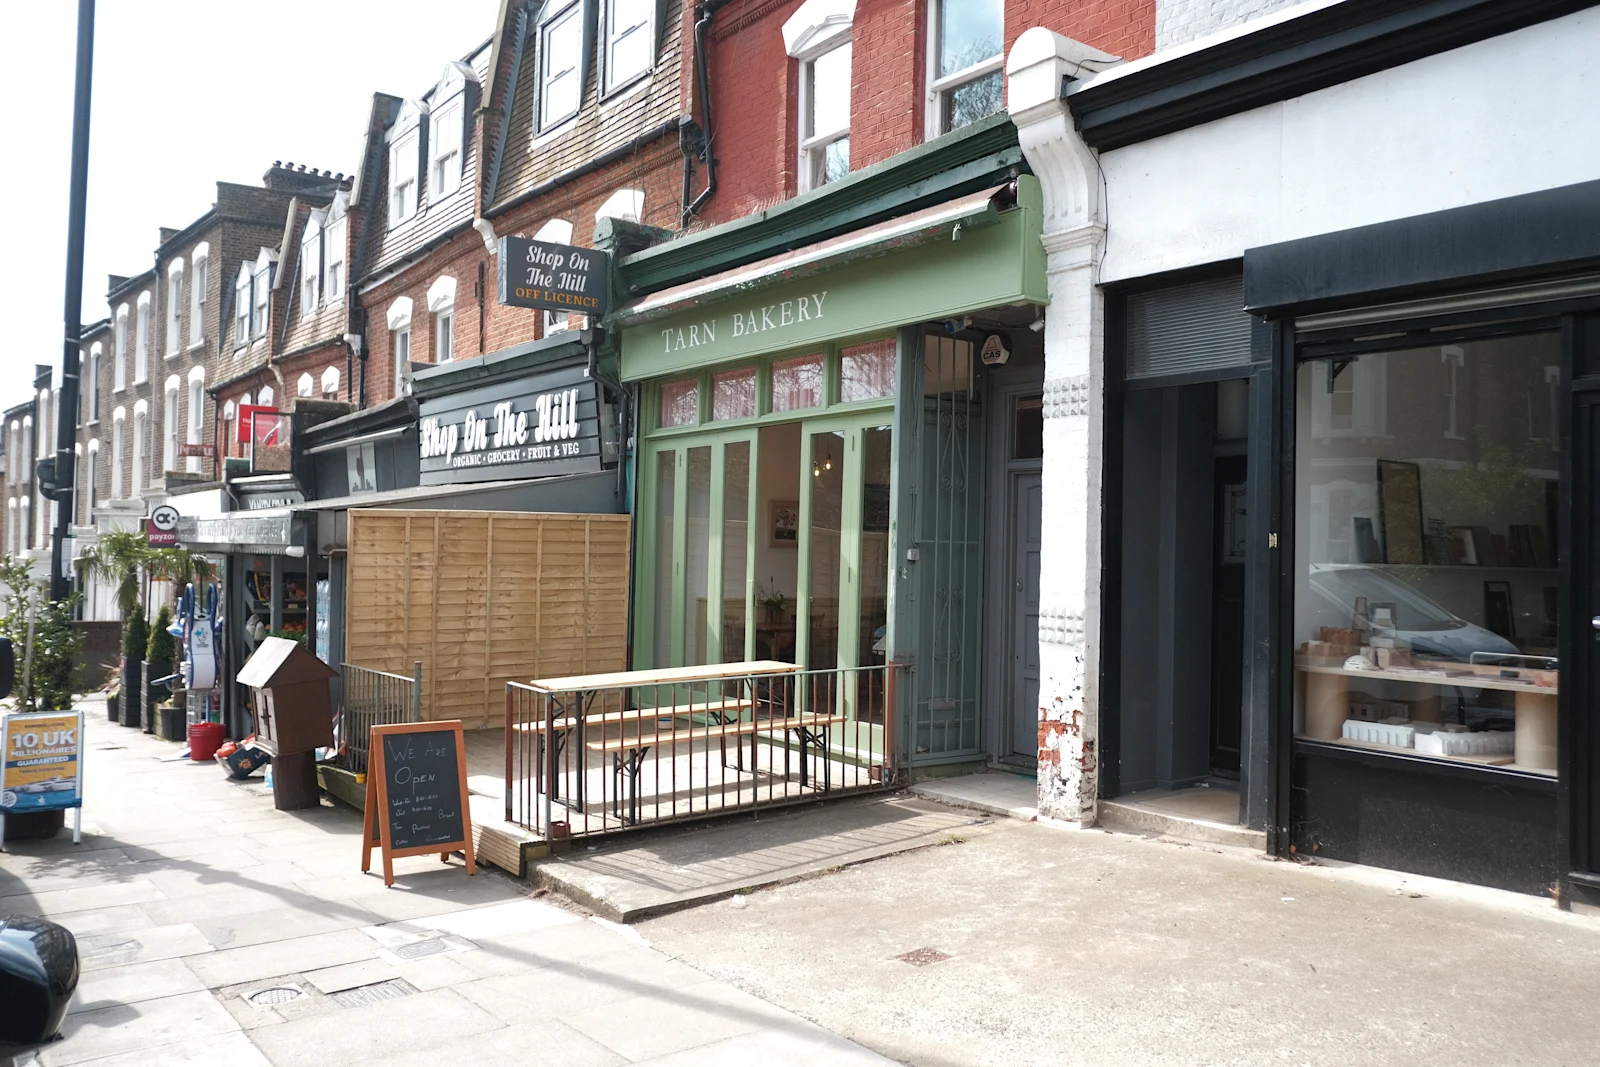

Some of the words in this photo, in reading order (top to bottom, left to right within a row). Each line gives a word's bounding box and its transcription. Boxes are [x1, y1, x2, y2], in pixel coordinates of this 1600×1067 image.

[526, 245, 564, 270] Shop
[569, 252, 590, 271] On
[526, 267, 553, 288] The
[557, 272, 587, 292] Hill
[515, 287, 540, 299] OFF
[544, 291, 599, 308] LICENCE
[661, 319, 717, 353] TARN
[732, 291, 828, 338] BAKERY
[983, 350, 1001, 360] CAS
[422, 416, 459, 465] Shop
[464, 409, 489, 452] On
[494, 401, 529, 449] The
[535, 388, 580, 443] Hill
[452, 453, 482, 467] ORGANIC
[487, 449, 521, 463] GROCERY
[528, 445, 551, 459] FRUIT
[554, 444, 560, 456] &
[563, 442, 580, 455] VEG
[12, 732, 39, 748] 10
[43, 729, 75, 746] UK
[10, 745, 77, 757] MILLIONAIRES
[16, 756, 69, 767] GUARANTEED
